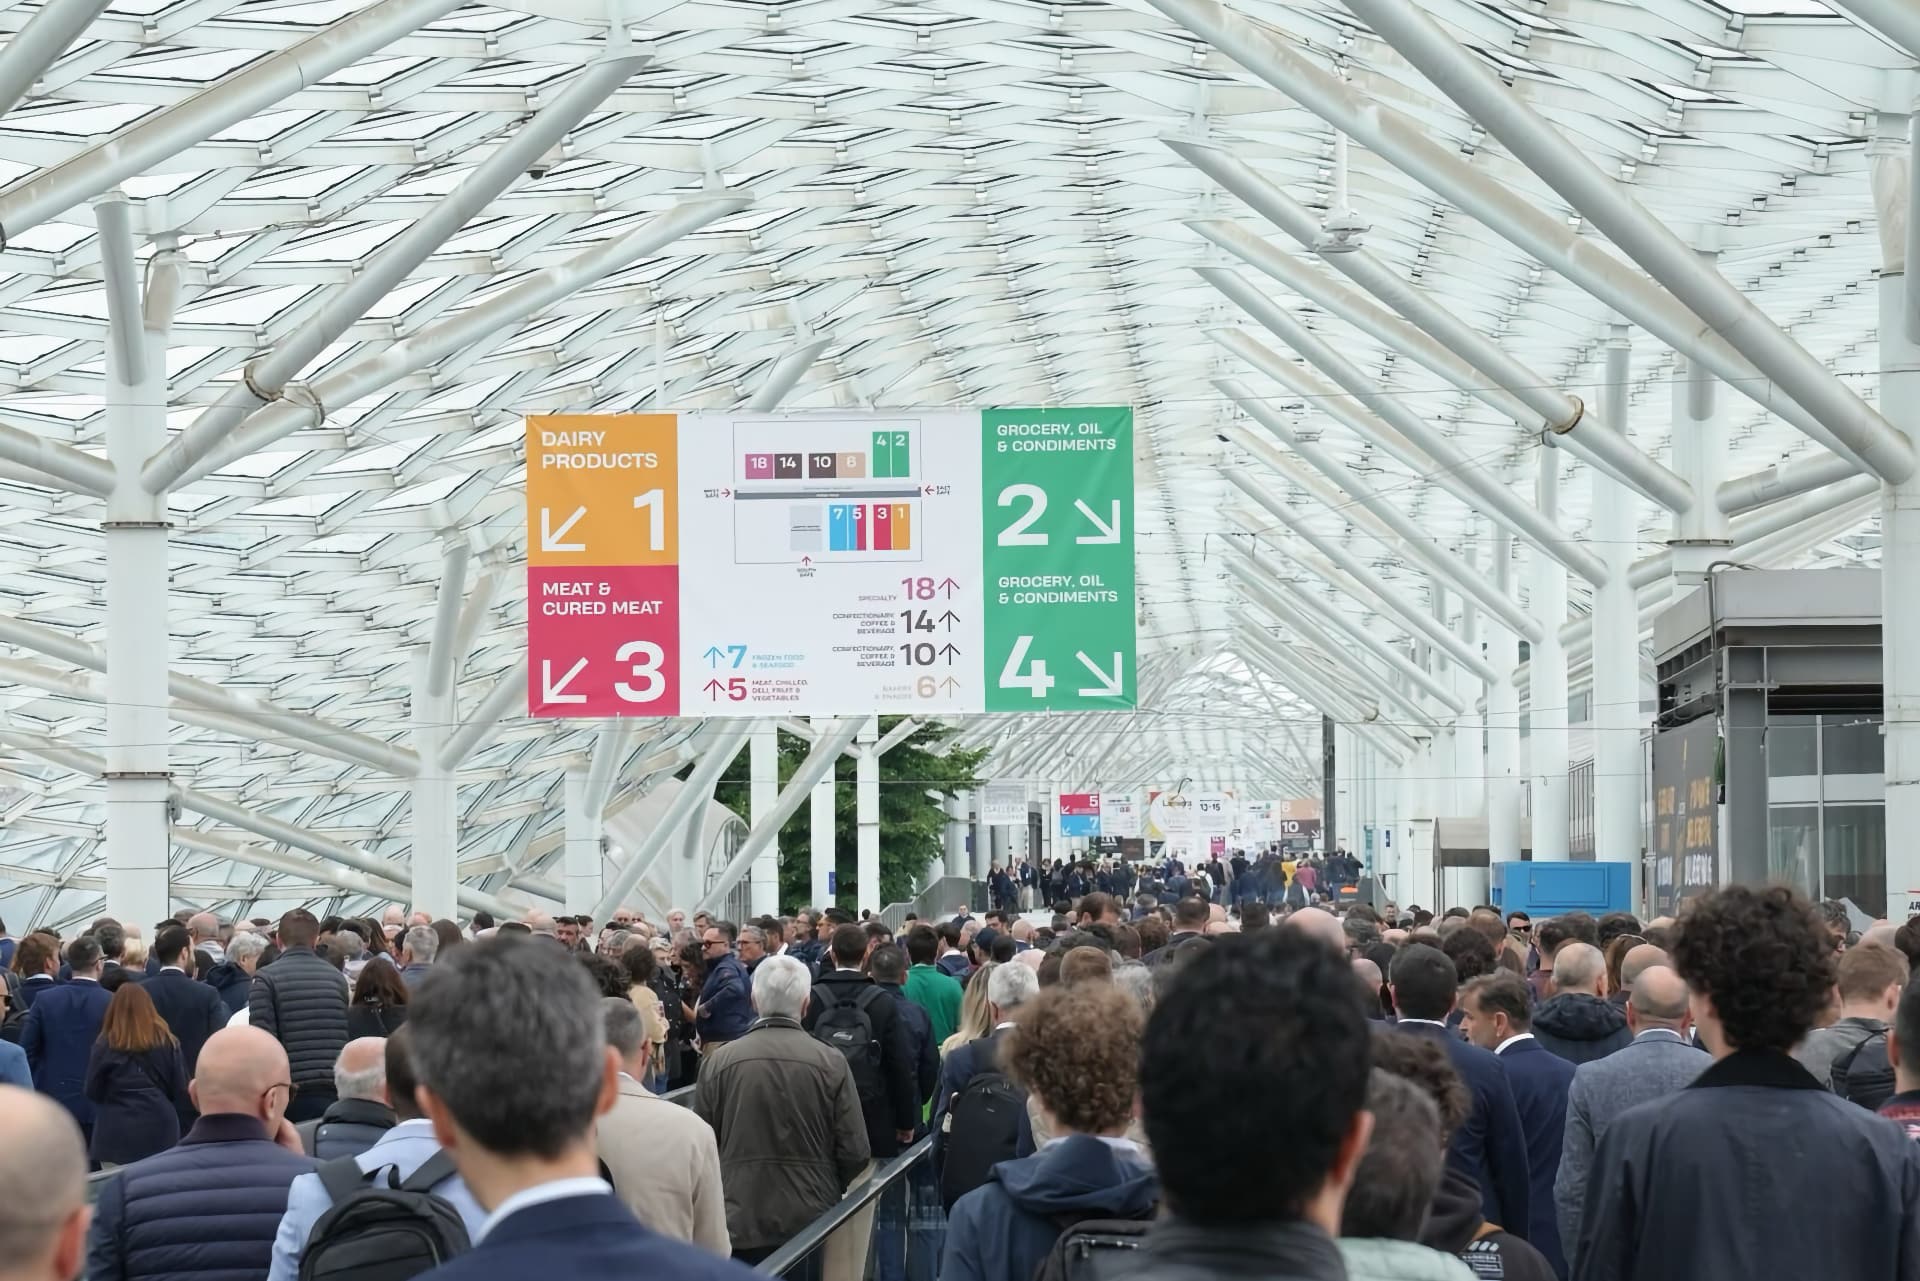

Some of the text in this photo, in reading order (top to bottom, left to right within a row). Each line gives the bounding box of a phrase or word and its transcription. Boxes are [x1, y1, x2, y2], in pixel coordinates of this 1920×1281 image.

[997, 423, 1103, 436] GROCERY, OIL
[542, 431, 606, 447] DAIRY
[876, 434, 887, 446] 4
[895, 434, 905, 446] 2
[997, 439, 1117, 452] & CONDIMENTS
[542, 452, 658, 469] PRODUCTS
[751, 456, 768, 469] 18
[779, 456, 797, 469] 14
[814, 456, 832, 468] 10
[634, 488, 665, 551] 1
[833, 508, 844, 520] 7
[852, 508, 863, 519] 5
[877, 507, 887, 519] 3
[898, 507, 904, 519] 1
[997, 483, 1049, 546] 2
[998, 575, 1104, 588] GROCERY, OIL
[543, 582, 611, 596] MEAT &
[902, 577, 936, 600] 18
[998, 591, 1118, 604] & CONDIMENTS
[543, 600, 663, 616] CURED MEAT
[900, 609, 936, 634] 14
[727, 644, 748, 669] 7
[900, 642, 936, 666] 10
[614, 640, 666, 703] 3
[999, 635, 1055, 698] 4
[728, 677, 748, 702] 5
[917, 675, 937, 699] 6
[1089, 795, 1099, 808] 5
[1090, 816, 1100, 829] 7
[1282, 820, 1300, 833] 10
